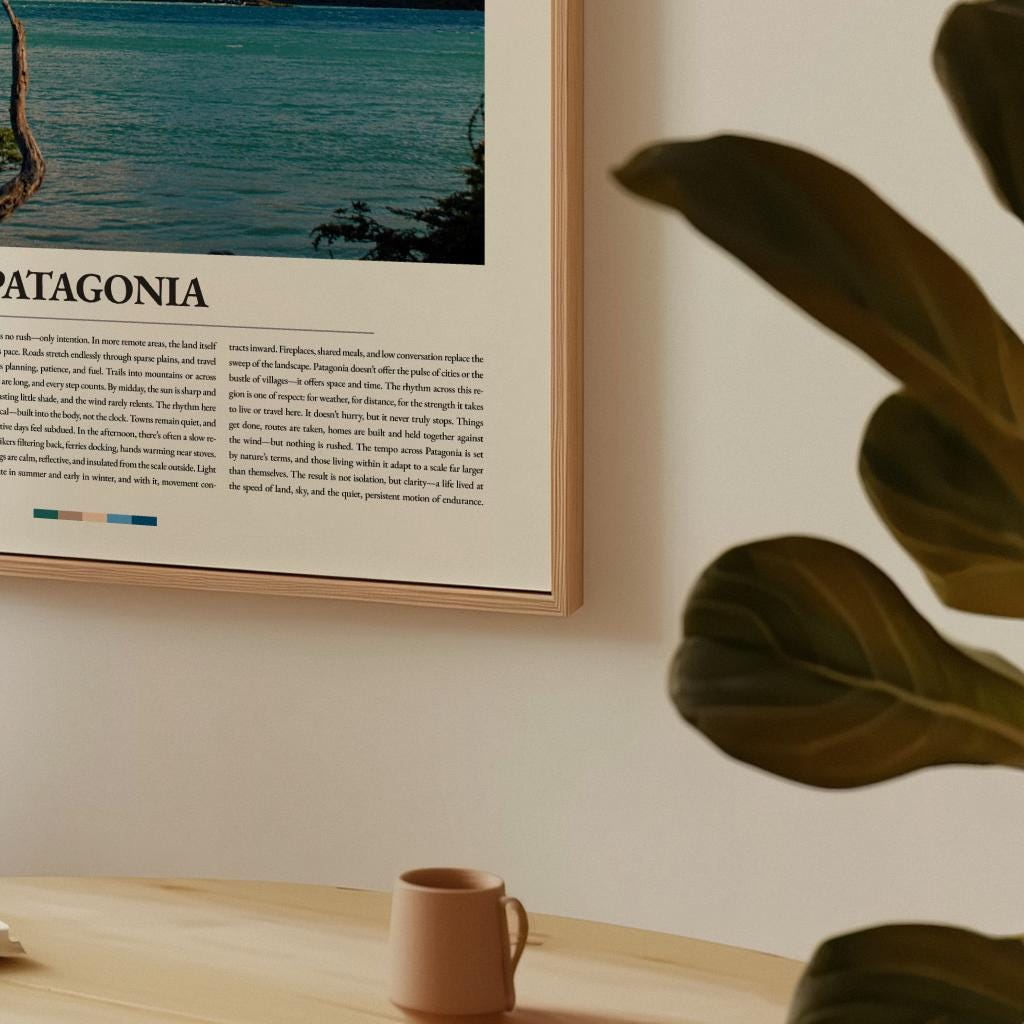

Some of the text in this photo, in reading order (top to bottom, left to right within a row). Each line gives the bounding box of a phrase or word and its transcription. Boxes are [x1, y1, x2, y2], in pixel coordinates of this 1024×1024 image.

[3, 349, 20, 358] pace.
[22, 348, 45, 357] Roads
[46, 350, 70, 358] stretch
[70, 350, 101, 363] endlessly
[102, 352, 132, 364] through
[133, 356, 155, 365] sparse
[156, 355, 180, 366] plains,
[181, 356, 195, 365] and
[196, 357, 216, 366] travel
[250, 344, 278, 353] inward.
[279, 345, 318, 357] Fireplaces,
[317, 347, 341, 357] shared
[342, 349, 366, 358] meals,
[366, 350, 381, 358] and
[381, 350, 396, 359] low
[396, 353, 443, 361] conversation
[444, 353, 470, 365] replace
[471, 354, 484, 363] the
[5, 362, 39, 375] planning,
[40, 365, 71, 375] patience,
[72, 366, 86, 375] and
[88, 366, 104, 376] fuel.
[106, 367, 126, 377] Trails
[128, 369, 143, 378] into
[144, 371, 183, 379] mountains
[20, 393, 37, 402] little
[37, 394, 59, 404] shade,
[60, 395, 74, 404] and
[75, 396, 87, 405] the
[88, 397, 107, 406] wind
[108, 398, 128, 410] rarely
[129, 399, 154, 409] relents.
[156, 400, 171, 410] The
[172, 401, 200, 413] rhythm
[201, 402, 216, 412] here
[228, 390, 245, 400] gion
[276, 392, 305, 404] respect:
[306, 393, 318, 402] for
[319, 395, 350, 405] weather,
[351, 395, 363, 405] for
[363, 396, 397, 408] distance,
[397, 397, 409, 407] for
[410, 399, 423, 408] the
[422, 401, 456, 412] strength
[464, 402, 484, 411] takes
[228, 422, 240, 431] get
[242, 421, 263, 431] done,
[264, 424, 287, 432] routes
[302, 424, 326, 435] taken,
[328, 425, 352, 435] homes
[367, 427, 386, 437] built
[388, 429, 403, 438] and
[404, 430, 421, 439] held
[423, 432, 455, 443] together
[457, 434, 484, 445] against
[17, 438, 45, 451] filtering
[45, 439, 65, 450] back,
[65, 441, 87, 450] ferries
[88, 442, 119, 455] docking,
[120, 444, 142, 454] hands
[142, 448, 176, 458] warming
[48, 471, 62, 479] and
[63, 472, 80, 483] early
[92, 474, 116, 484] winter,
[118, 475, 132, 484] and
[133, 476, 151, 485] with
[152, 477, 160, 487] it,
[162, 480, 199, 488] movement
[229, 481, 241, 491] the
[242, 483, 263, 494] speed
[275, 484, 294, 495] land,
[295, 486, 309, 497] sky,
[310, 487, 325, 496] and
[327, 488, 340, 497] the
[341, 490, 363, 500] quiet,
[365, 492, 400, 501] persistent
[402, 494, 430, 503] motion
[441, 496, 484, 506] endurance.
